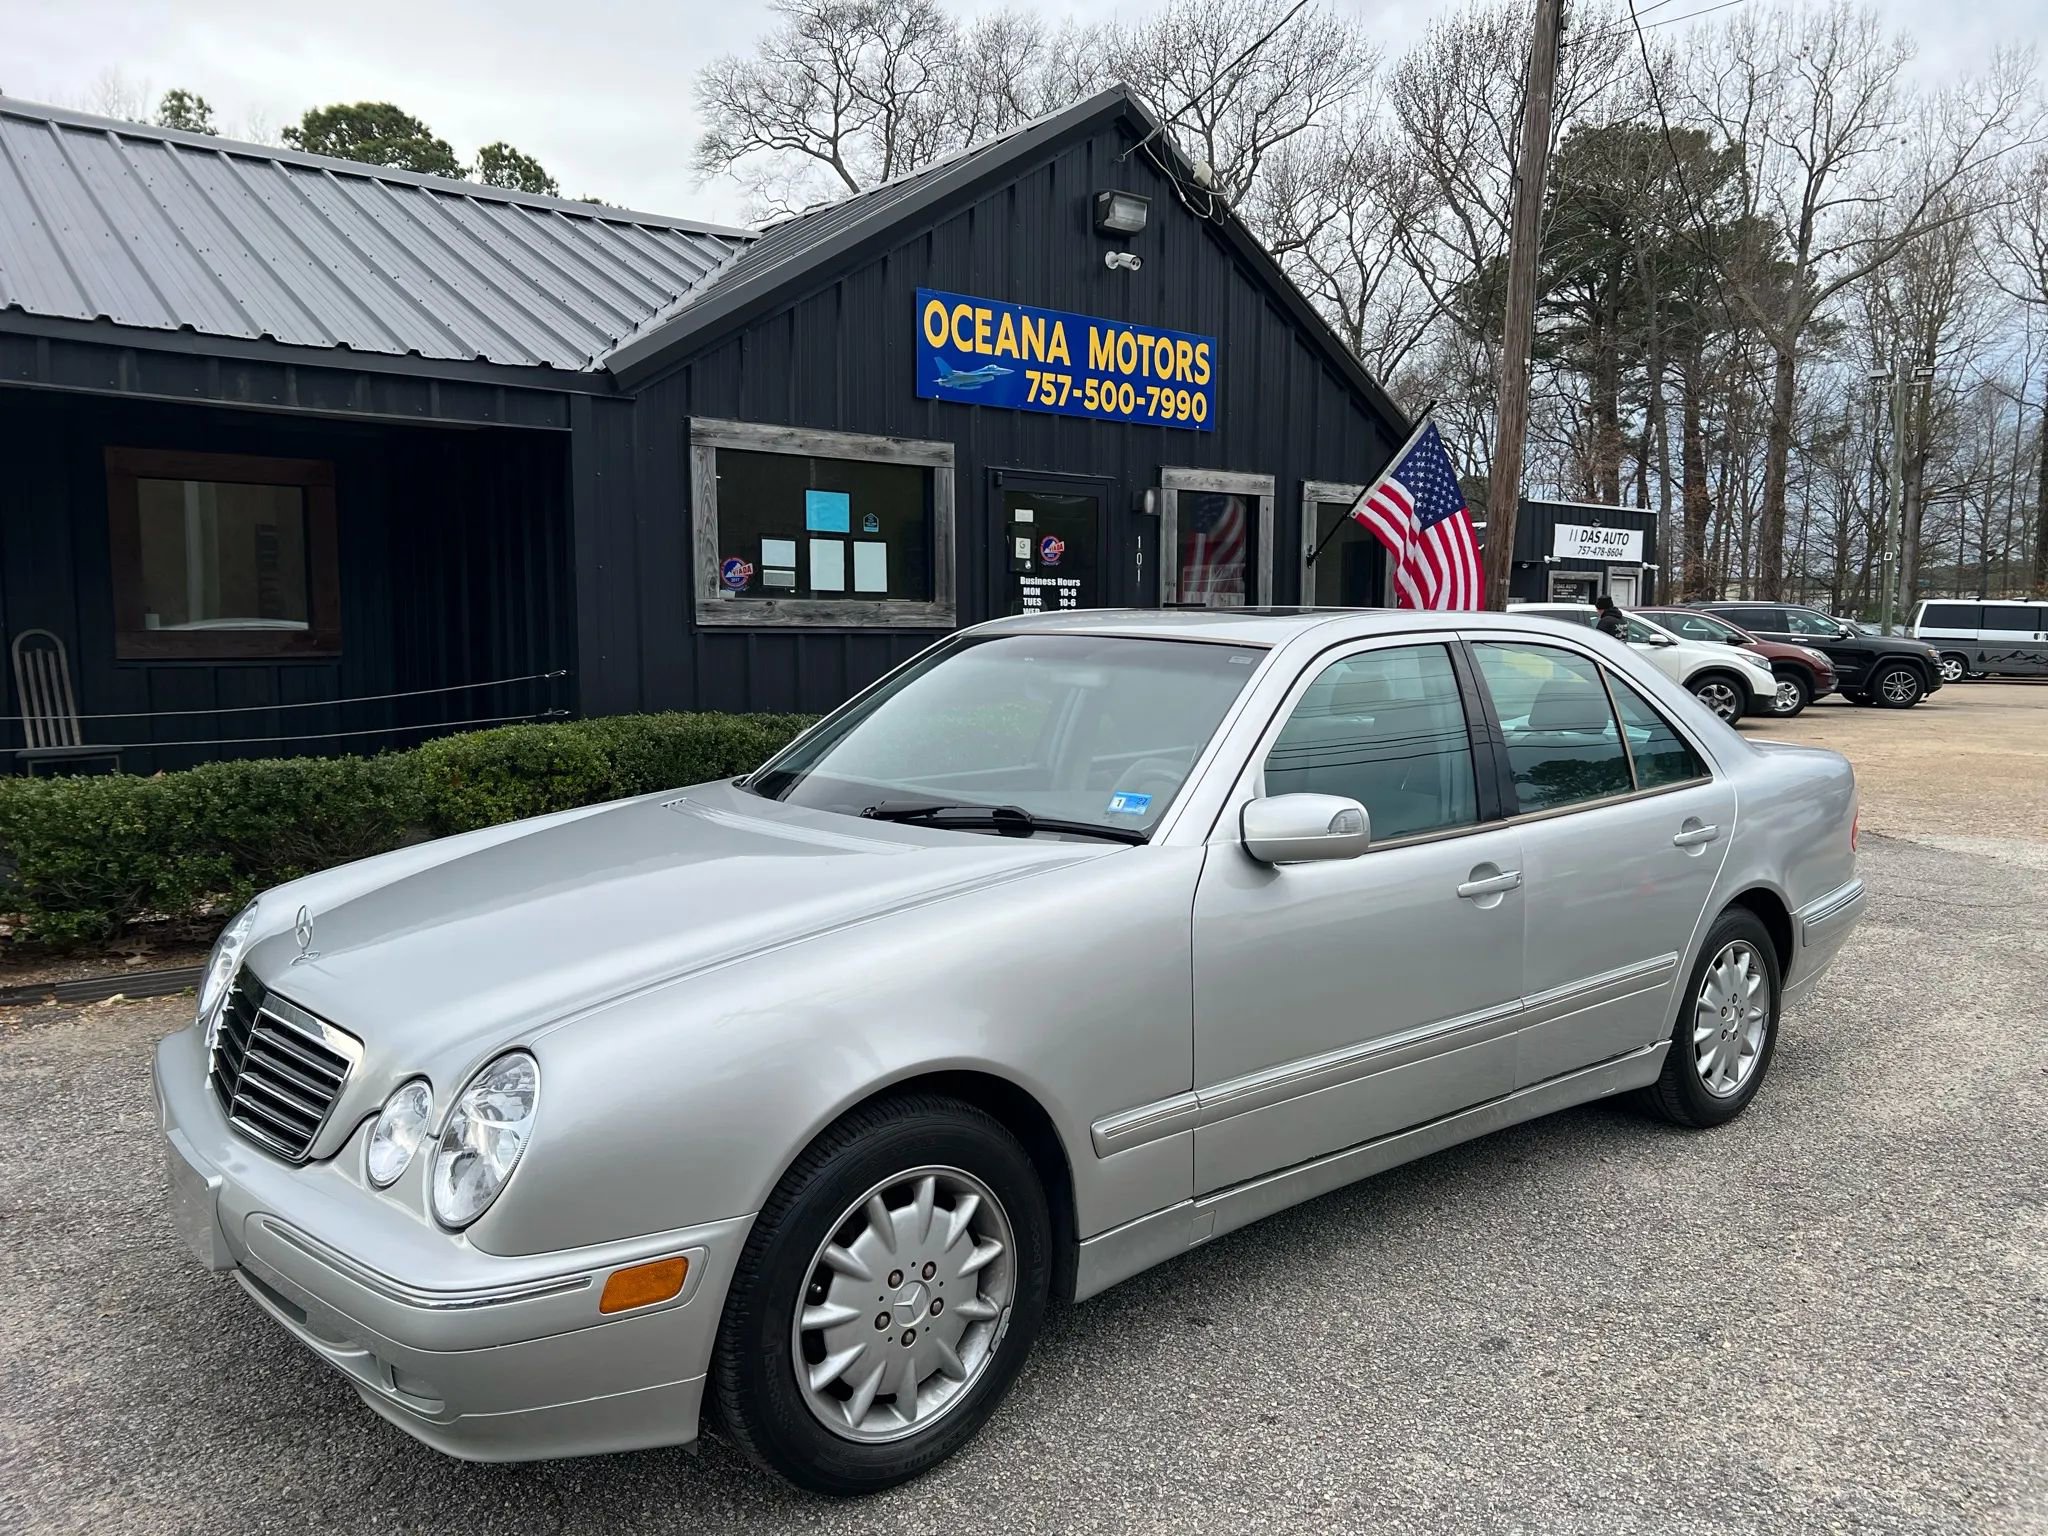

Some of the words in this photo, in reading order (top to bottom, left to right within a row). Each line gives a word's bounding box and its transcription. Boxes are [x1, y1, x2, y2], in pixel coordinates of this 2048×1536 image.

[923, 299, 1071, 367] OCEANA
[1089, 325, 1211, 386] MOTORS
[1025, 370, 1208, 423] 757-500-7990
[1580, 529, 1602, 544] DAS
[1601, 531, 1630, 546] AUTO
[1020, 576, 1057, 586] Business
[1057, 577, 1081, 587] Hours
[1023, 587, 1041, 596] MON
[1060, 588, 1077, 597] 10-6
[1023, 597, 1042, 606] TUES
[1059, 598, 1077, 607] 10-6
